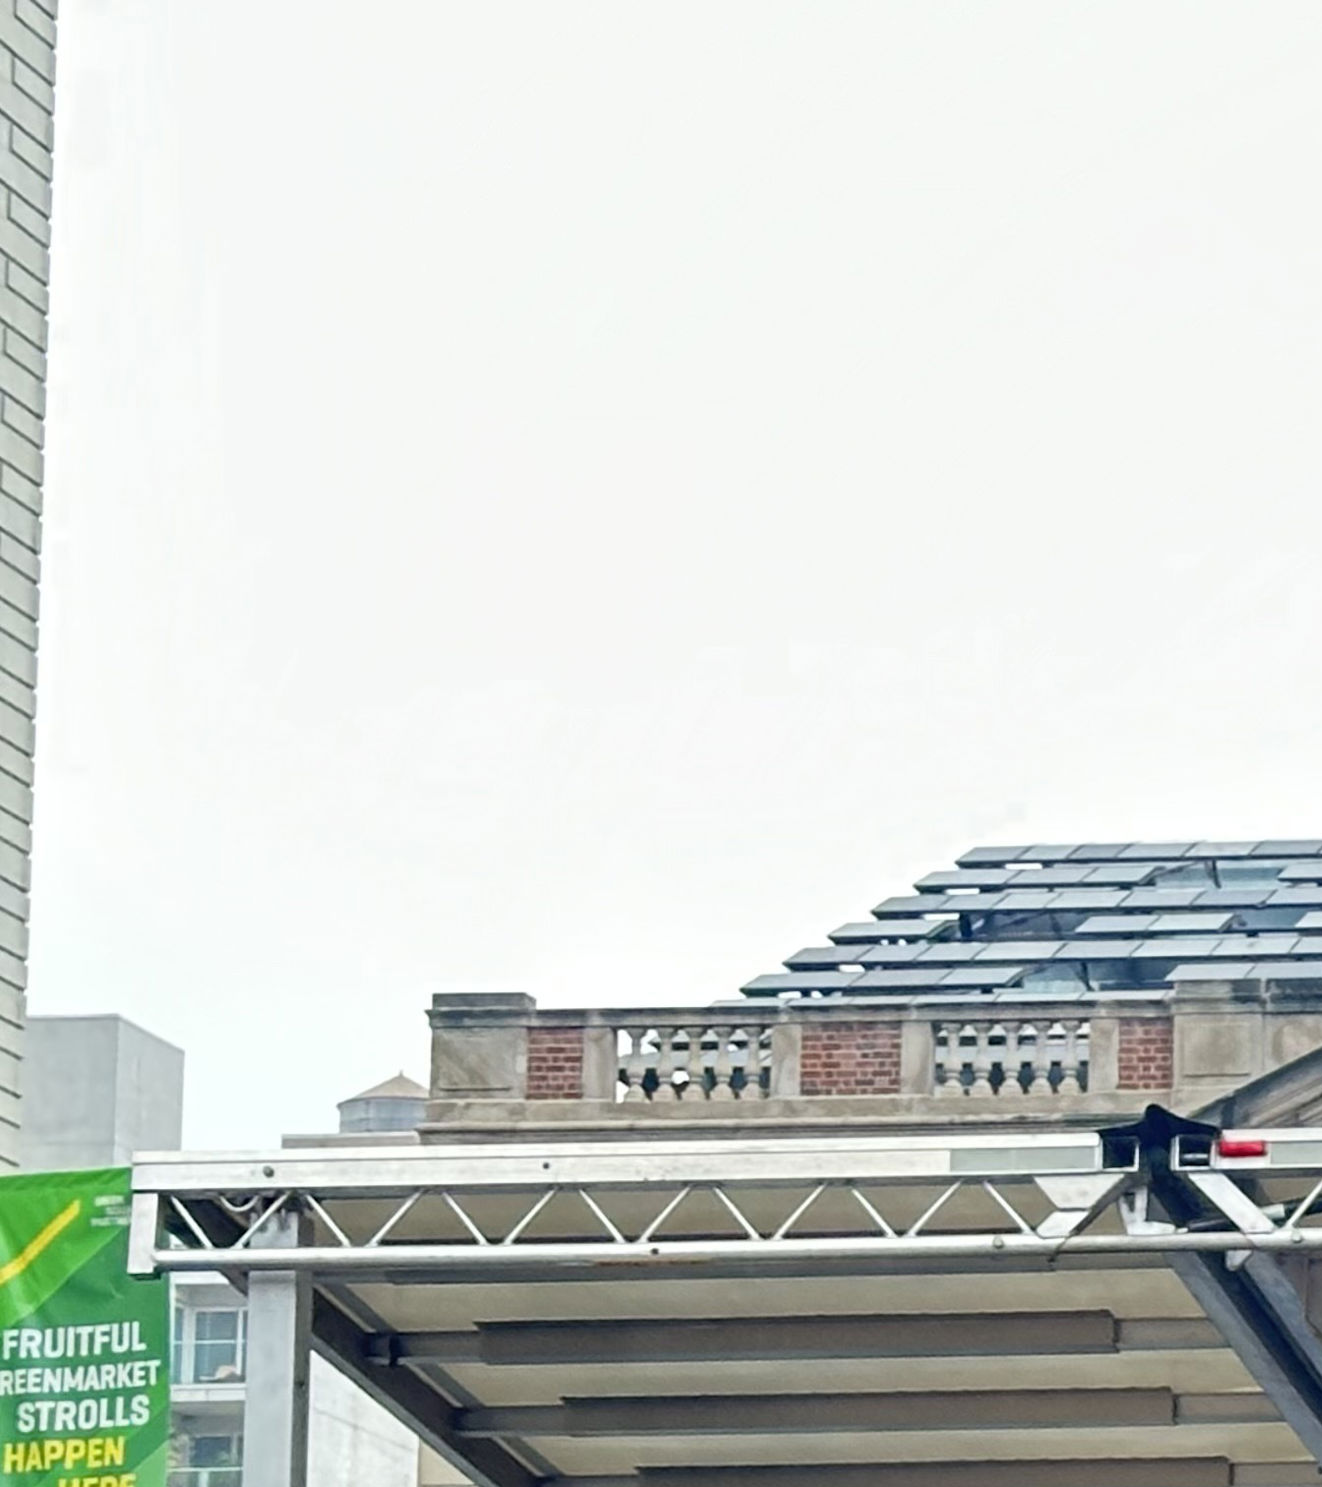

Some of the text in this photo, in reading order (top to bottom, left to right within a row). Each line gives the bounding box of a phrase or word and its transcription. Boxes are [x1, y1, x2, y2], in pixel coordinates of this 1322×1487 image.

[3, 1321, 147, 1360] FRUITFUL
[0, 1360, 161, 1396] REENMARKET
[17, 1394, 150, 1433] STROLLS
[4, 1436, 125, 1474] HAPPEN
